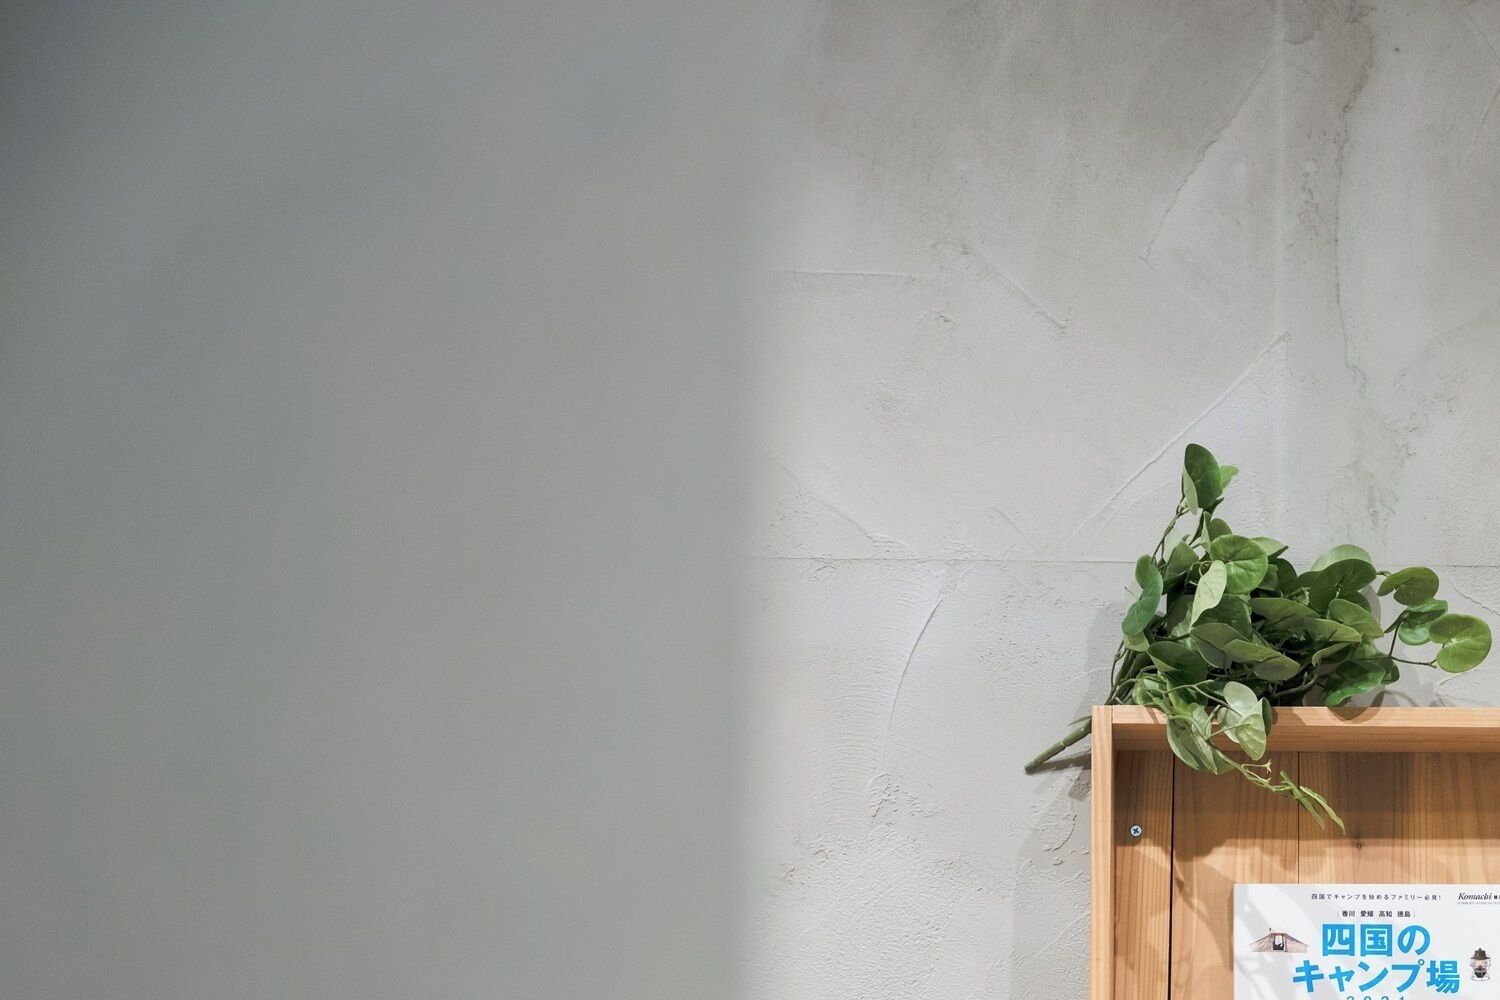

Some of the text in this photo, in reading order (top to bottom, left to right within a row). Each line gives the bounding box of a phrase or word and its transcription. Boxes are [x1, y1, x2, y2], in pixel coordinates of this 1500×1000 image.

[1458, 892, 1492, 900] Komachi
[1322, 923, 1431, 957] 四国の
[1292, 959, 1461, 994] キャンプ場
